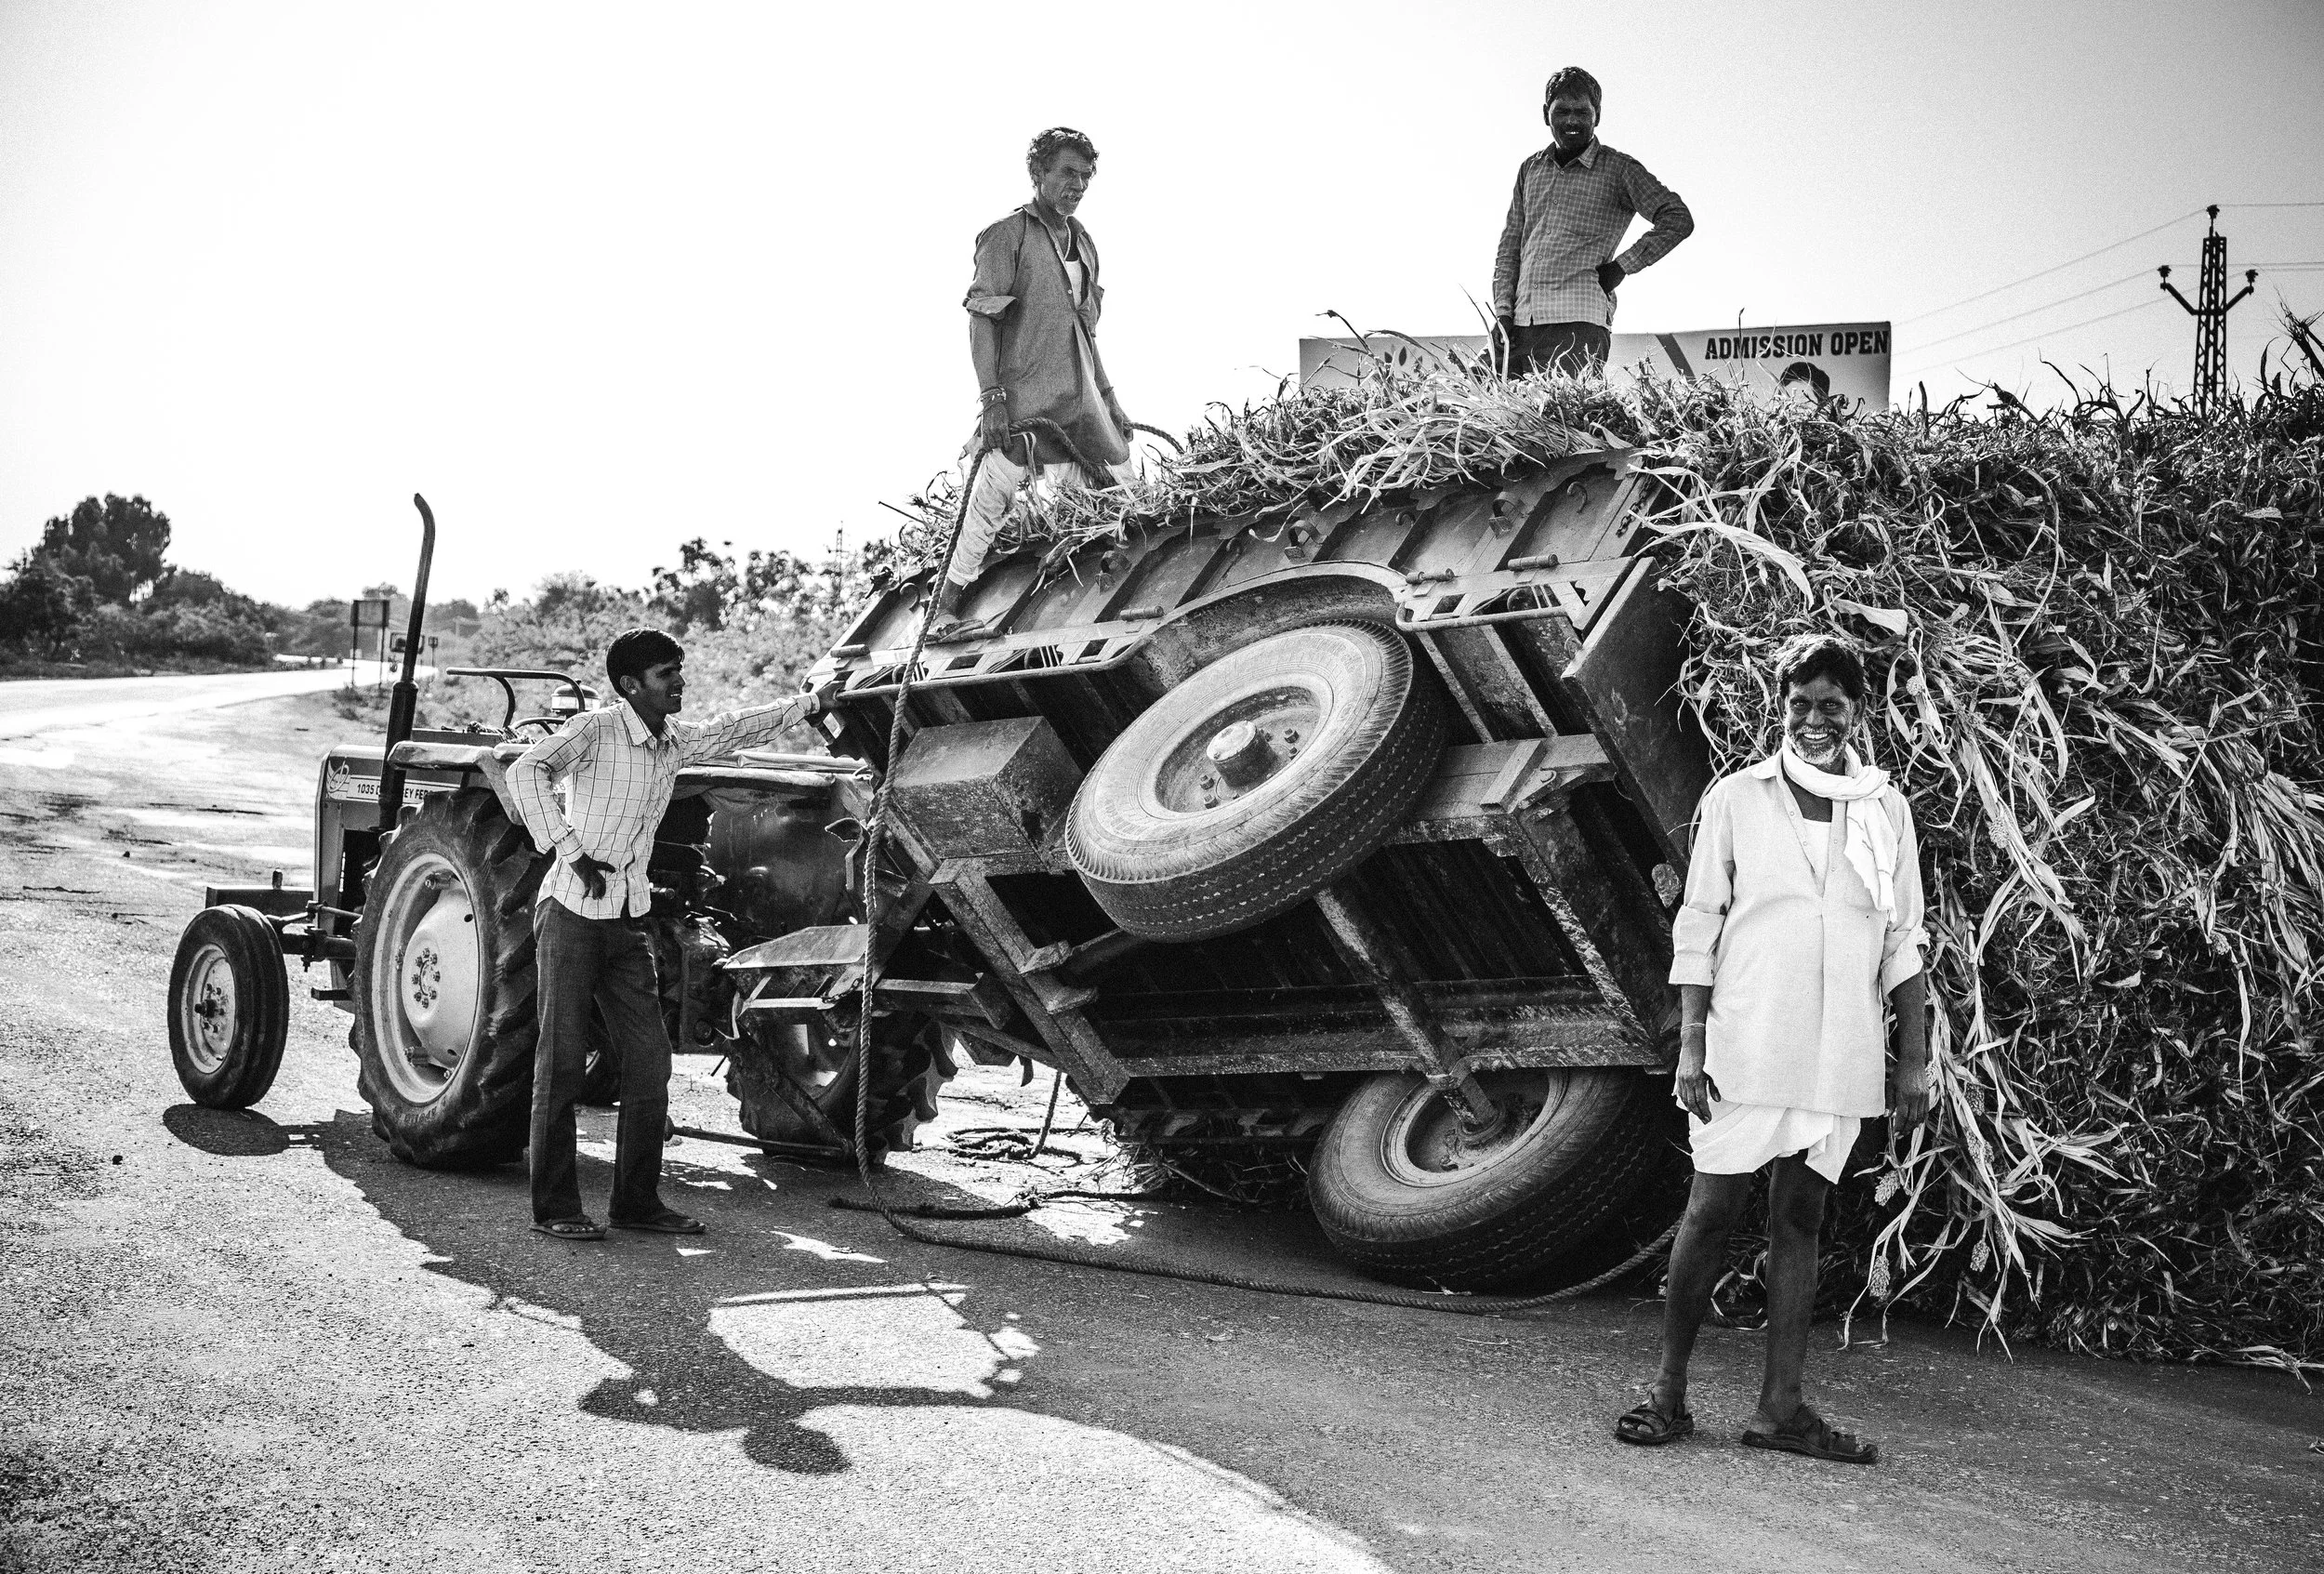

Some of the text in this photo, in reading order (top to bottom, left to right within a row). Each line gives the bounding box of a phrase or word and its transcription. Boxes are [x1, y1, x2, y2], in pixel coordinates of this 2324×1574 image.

[1705, 330, 1890, 360] ADMISSION OPEN
[357, 784, 375, 795] 1035
